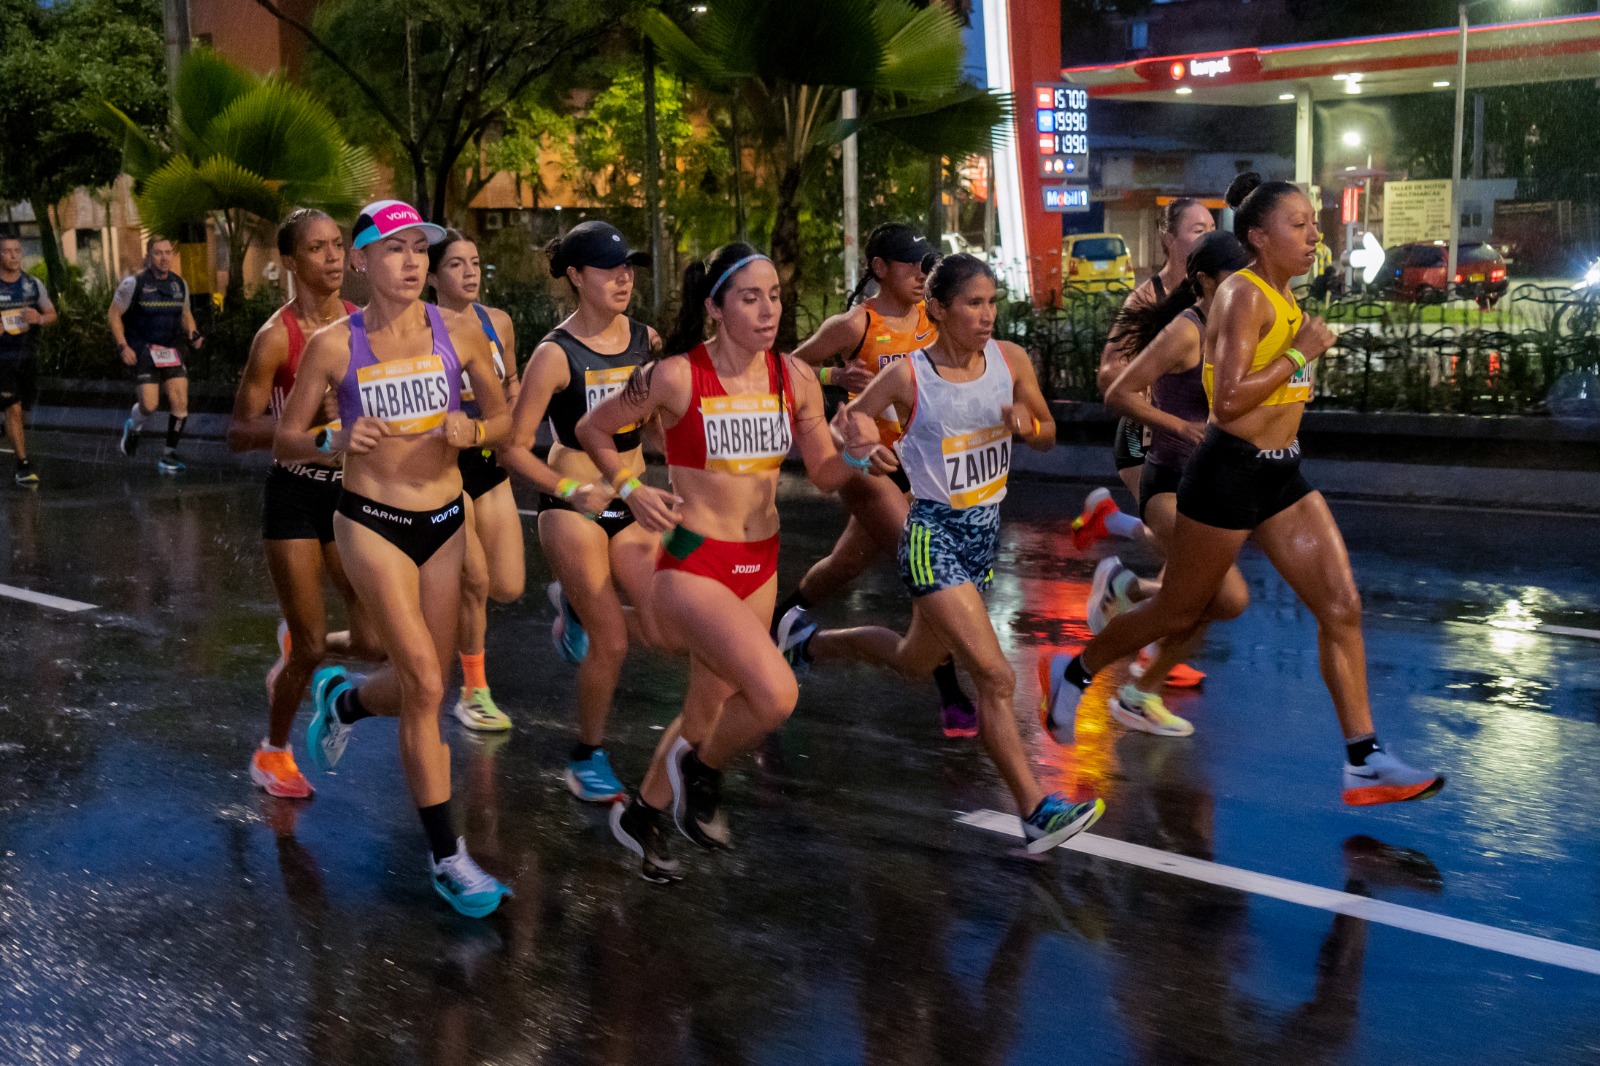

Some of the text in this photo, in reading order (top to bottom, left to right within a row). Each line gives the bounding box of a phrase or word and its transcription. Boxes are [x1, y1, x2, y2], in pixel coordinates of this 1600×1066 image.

[361, 375, 448, 418] TABARES
[706, 417, 790, 456] GABRIELA
[946, 441, 1009, 491] ZAIDA
[362, 505, 413, 526] GARMIN
